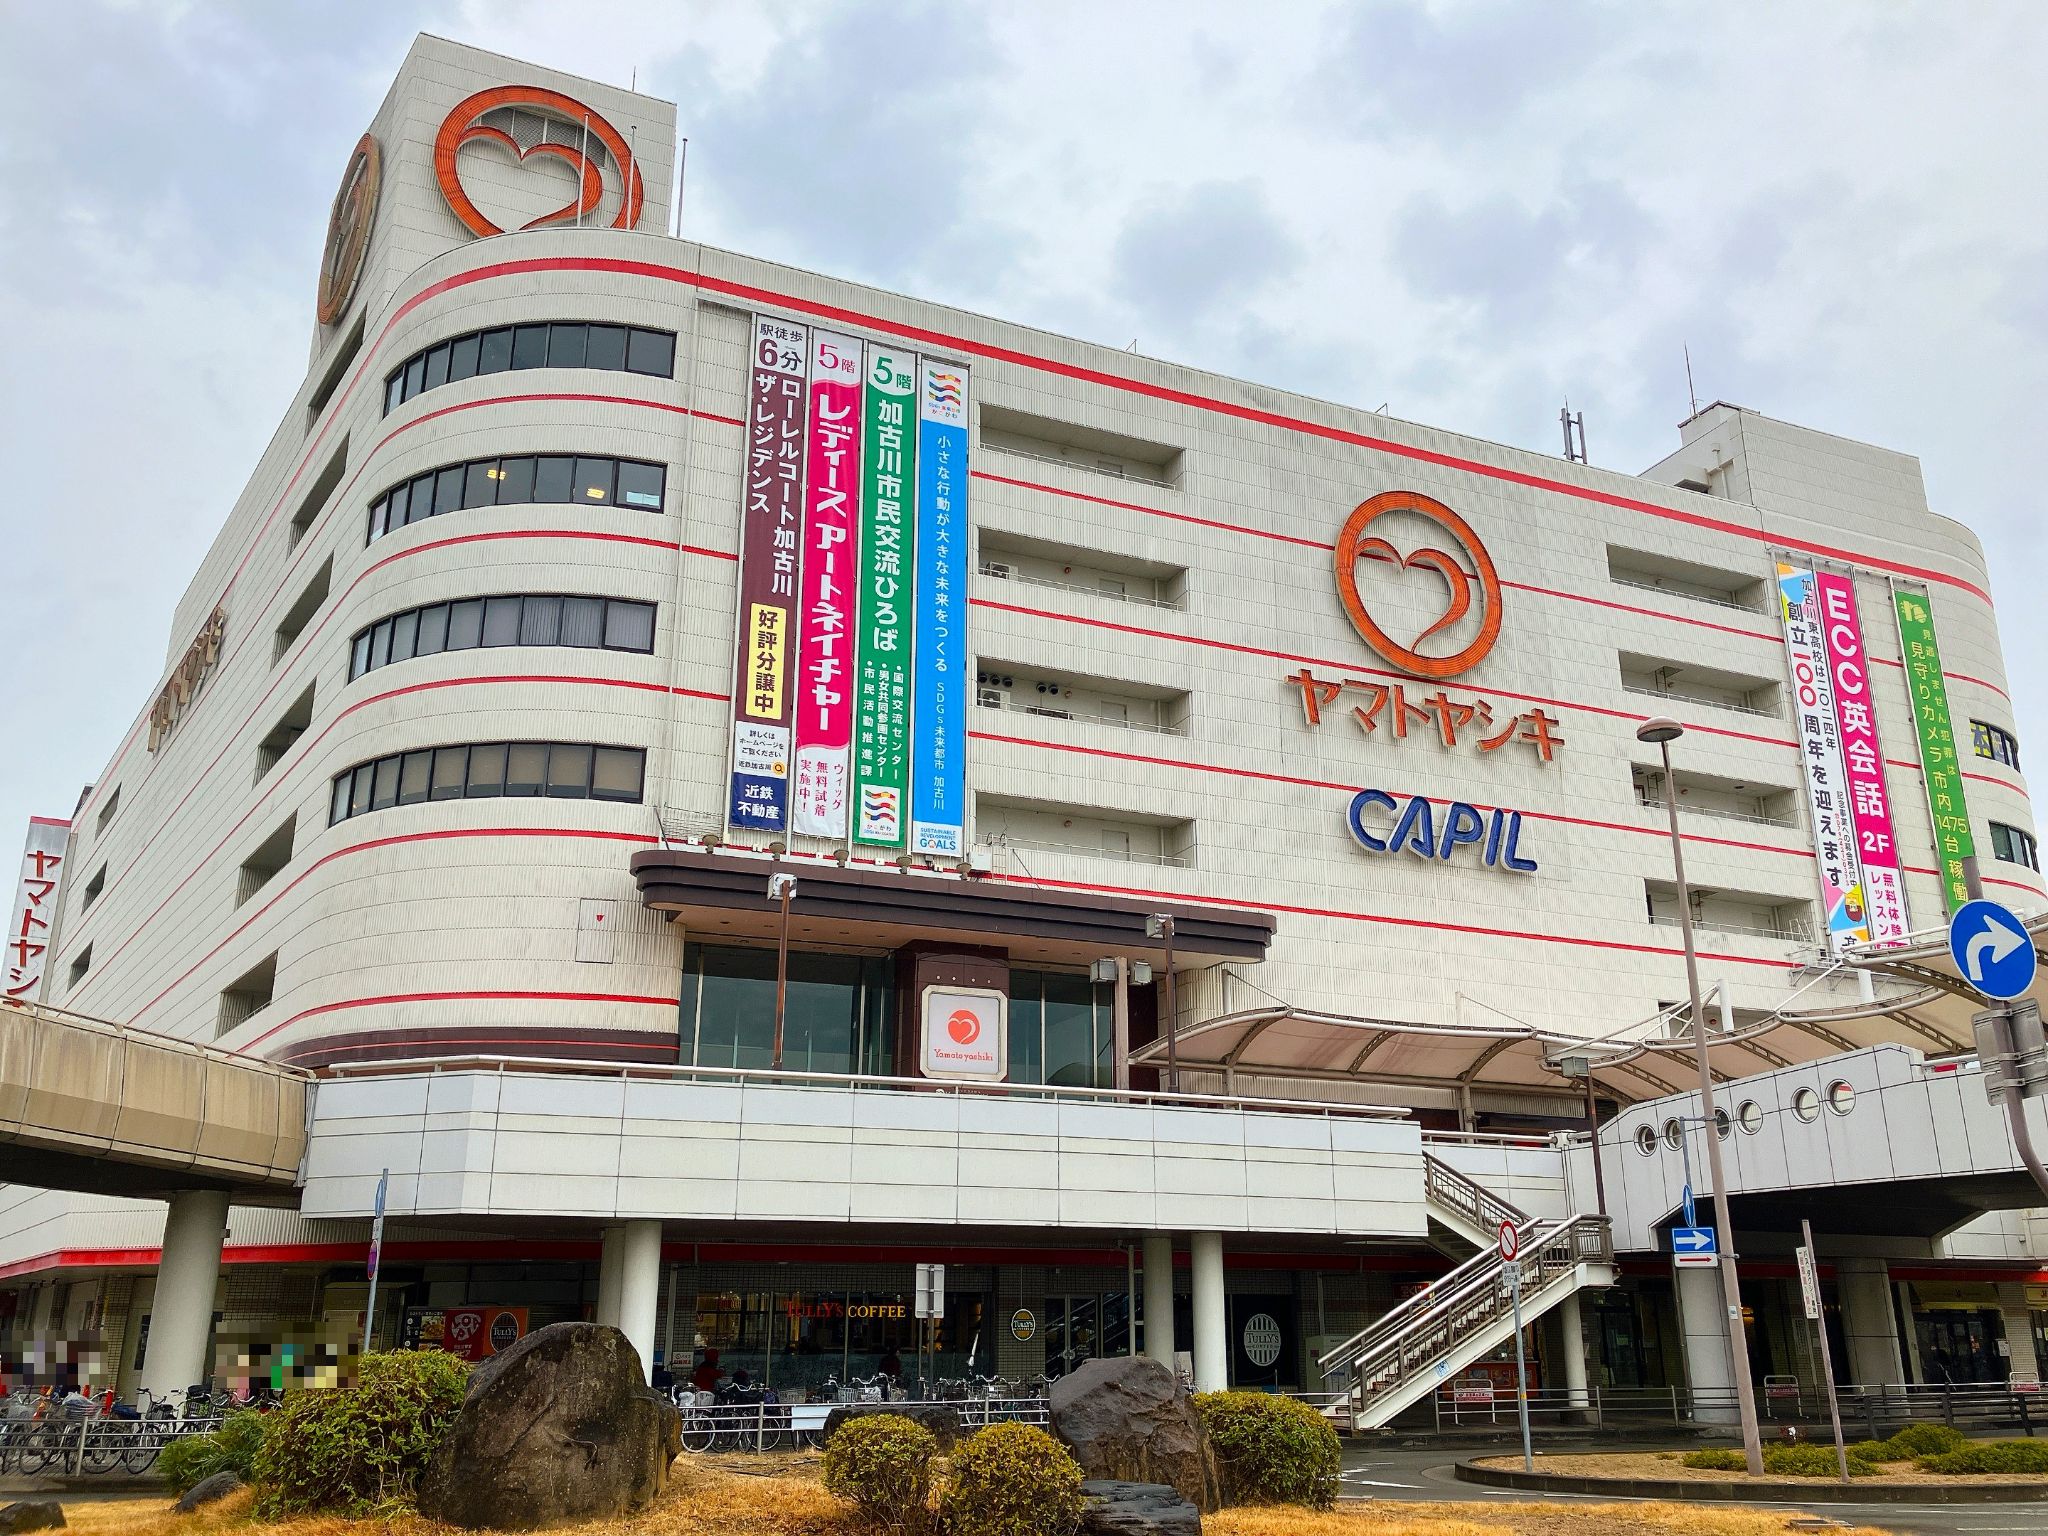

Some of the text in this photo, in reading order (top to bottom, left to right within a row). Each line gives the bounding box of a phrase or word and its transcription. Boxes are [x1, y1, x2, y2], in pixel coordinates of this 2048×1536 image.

[760, 323, 803, 342] 駅徒歩
[759, 338, 803, 371] 6分
[818, 343, 856, 374] 5階
[873, 356, 912, 390] 5階
[750, 373, 777, 514] ザ・レジデンス
[772, 378, 800, 597] ローレルコート加古川
[874, 399, 903, 652] 加古川市民交流ひろば
[809, 394, 853, 731] レディースアートネイチャー
[934, 436, 952, 672] 小さな行動が大きな未来をつくる
[754, 609, 778, 713] 好評分譲中
[1284, 668, 1565, 762] ヤマトヤシキ
[1826, 587, 1885, 819] ECC英会話
[1923, 629, 1956, 776] 見逃しません犯罪は
[740, 738, 784, 750] ホームページを
[741, 747, 781, 758] ご覧ください
[750, 730, 776, 740] 詳しくは
[745, 784, 773, 800] 近鉄
[814, 761, 829, 817] 無料試着
[833, 763, 844, 811] ウィッグ
[933, 776, 945, 811] 加古川
[738, 801, 780, 820] 不動産
[1346, 788, 1538, 872] CAPIL
[919, 838, 957, 851] GOALS
[1862, 831, 1890, 854] 2F
[1871, 871, 1889, 936] レッスン
[1882, 872, 1902, 937] 無料体験
[847, 1305, 906, 1318] COFFEE
[1245, 1332, 1279, 1344] TULLY'S
